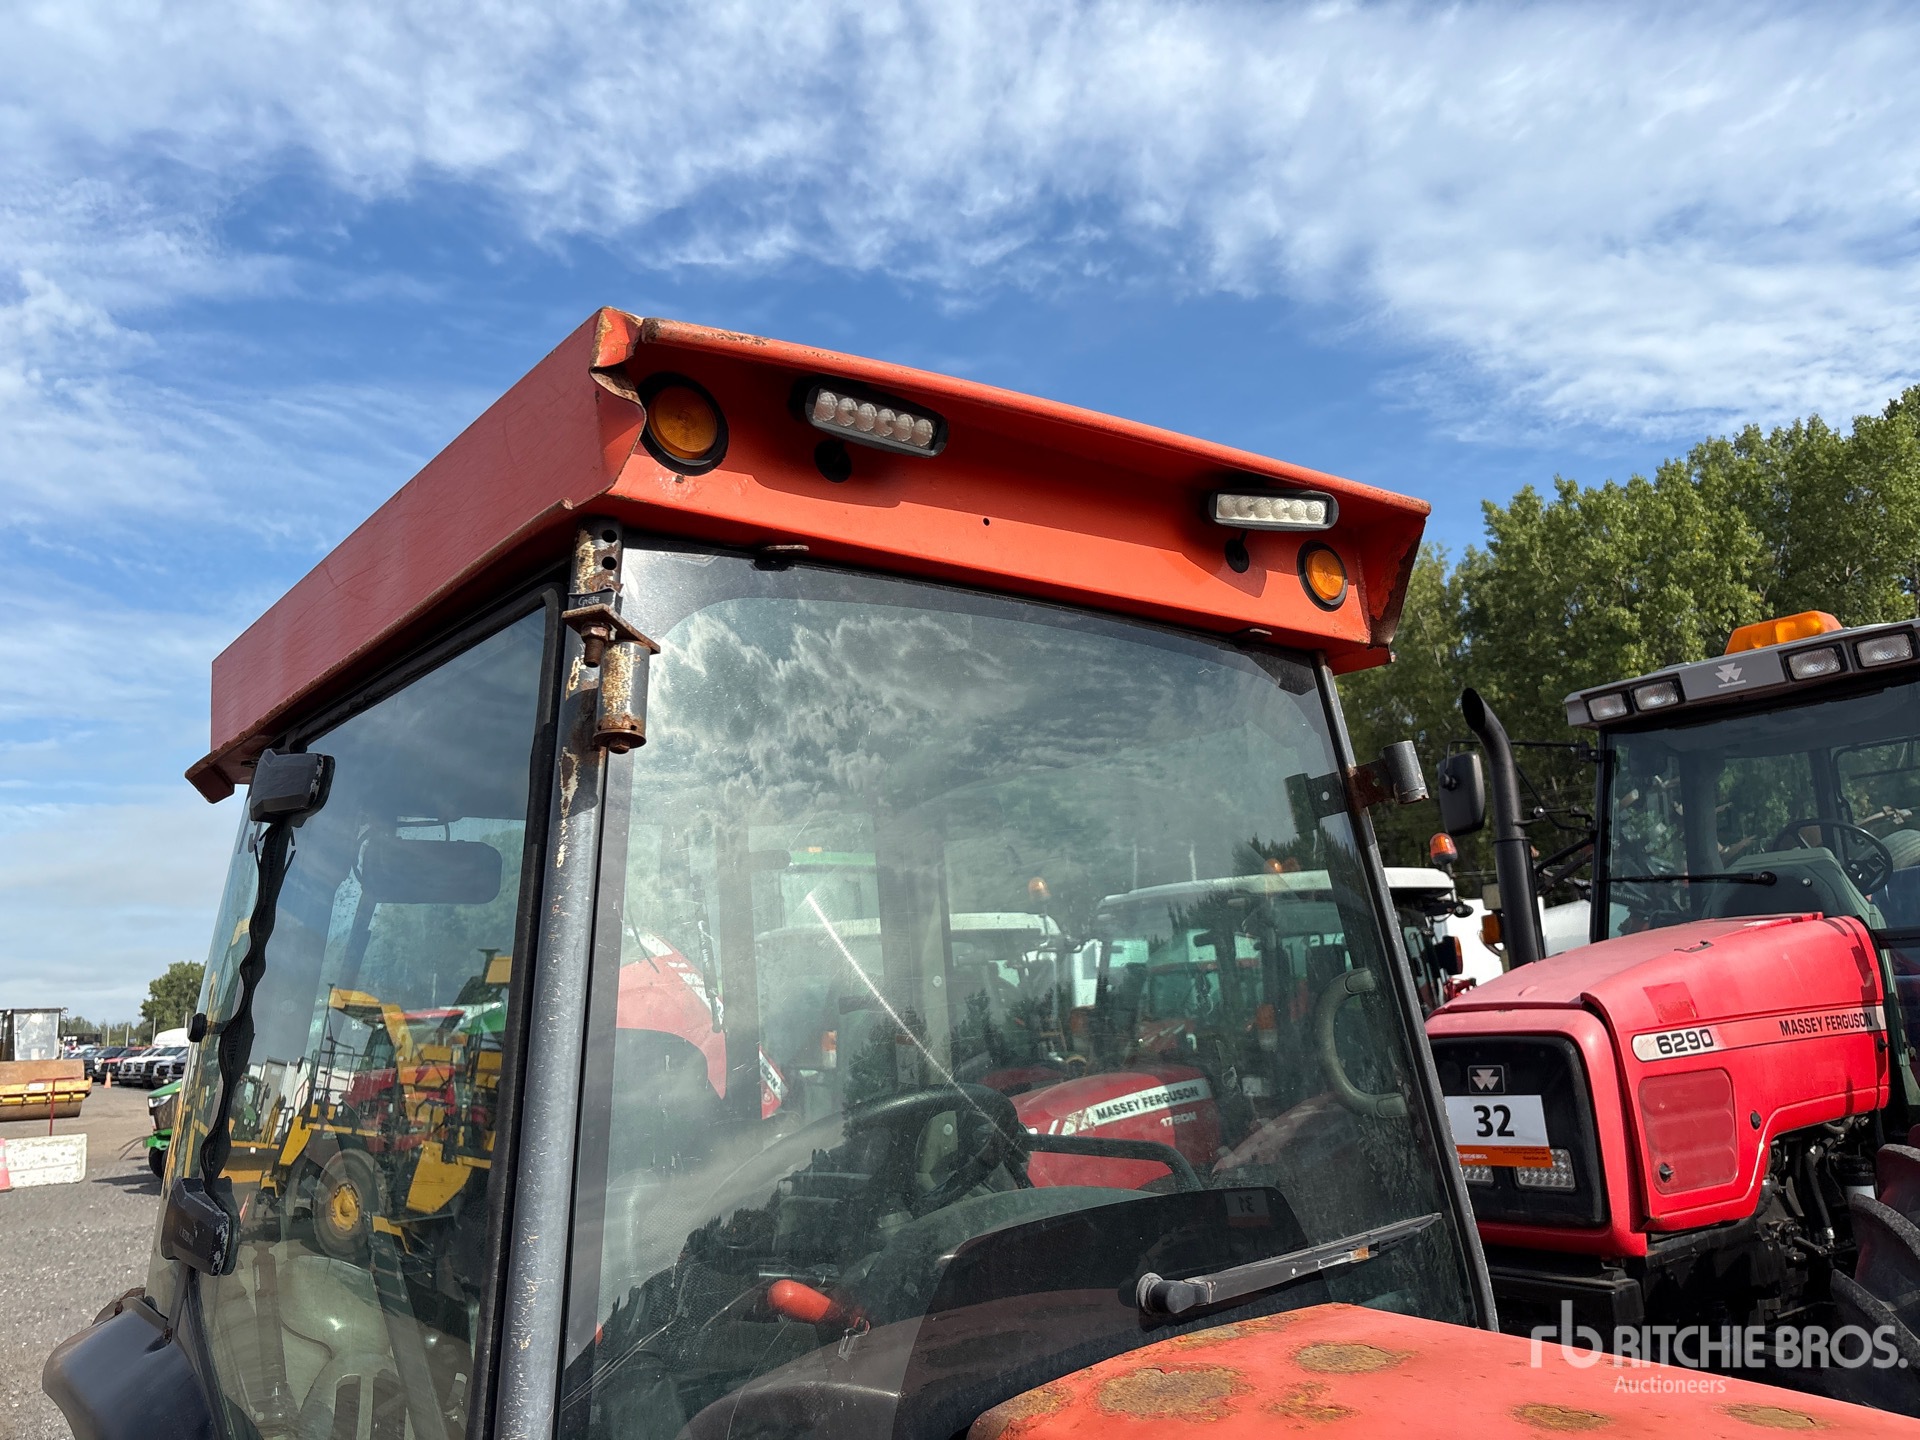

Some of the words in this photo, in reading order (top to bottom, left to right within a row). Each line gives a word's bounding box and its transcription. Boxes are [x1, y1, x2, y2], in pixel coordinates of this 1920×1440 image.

[1778, 1016, 1823, 1036] MASSEY
[1825, 1012, 1873, 1031] FERGUSON
[1655, 1028, 1714, 1055] 6290
[1096, 1098, 1141, 1120] MASSEY
[1141, 1086, 1200, 1109] FERGUSON
[1473, 1104, 1515, 1138] 32
